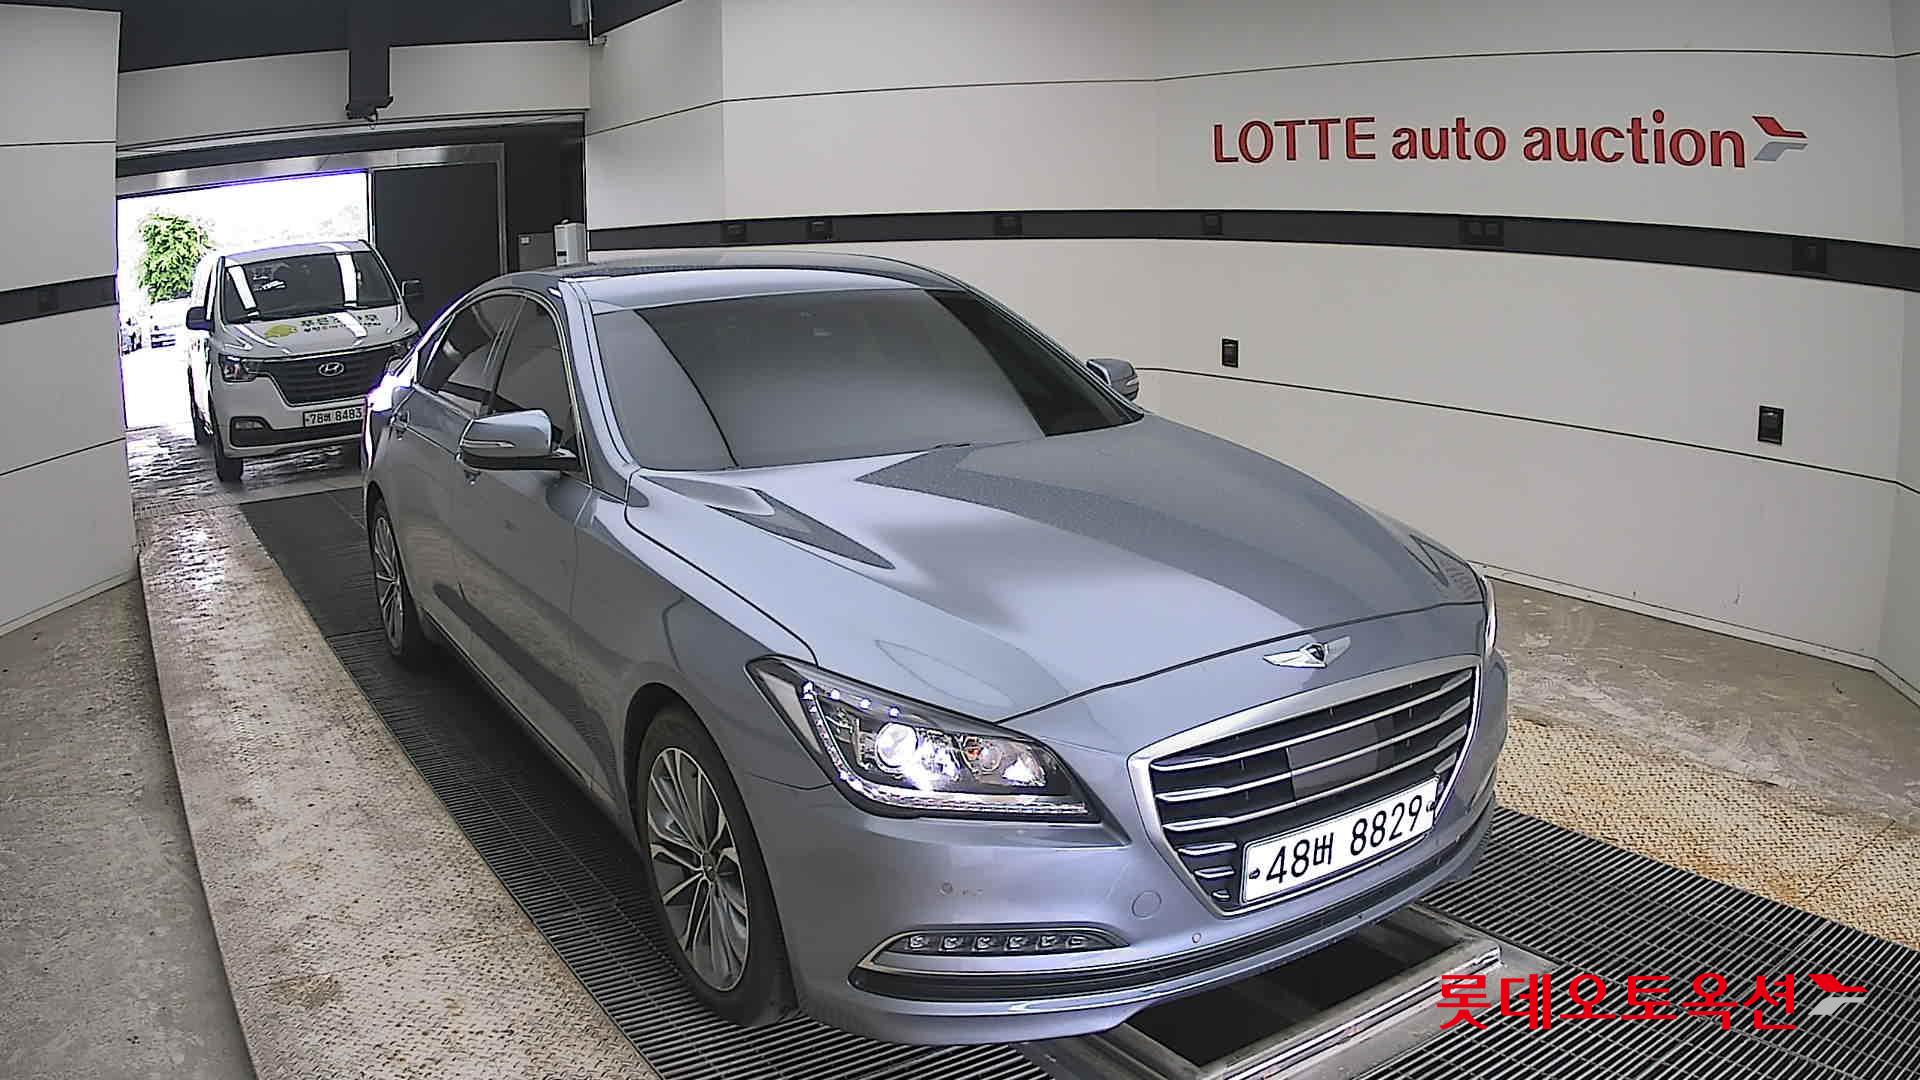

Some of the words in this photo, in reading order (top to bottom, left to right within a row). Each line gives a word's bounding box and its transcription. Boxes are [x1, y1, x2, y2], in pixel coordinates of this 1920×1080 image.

[1213, 116, 1376, 163] LOTTE
[1391, 117, 1507, 161] auto
[1522, 109, 1746, 168] auction
[1265, 832, 1335, 884] 48버
[1350, 794, 1423, 856] 8829
